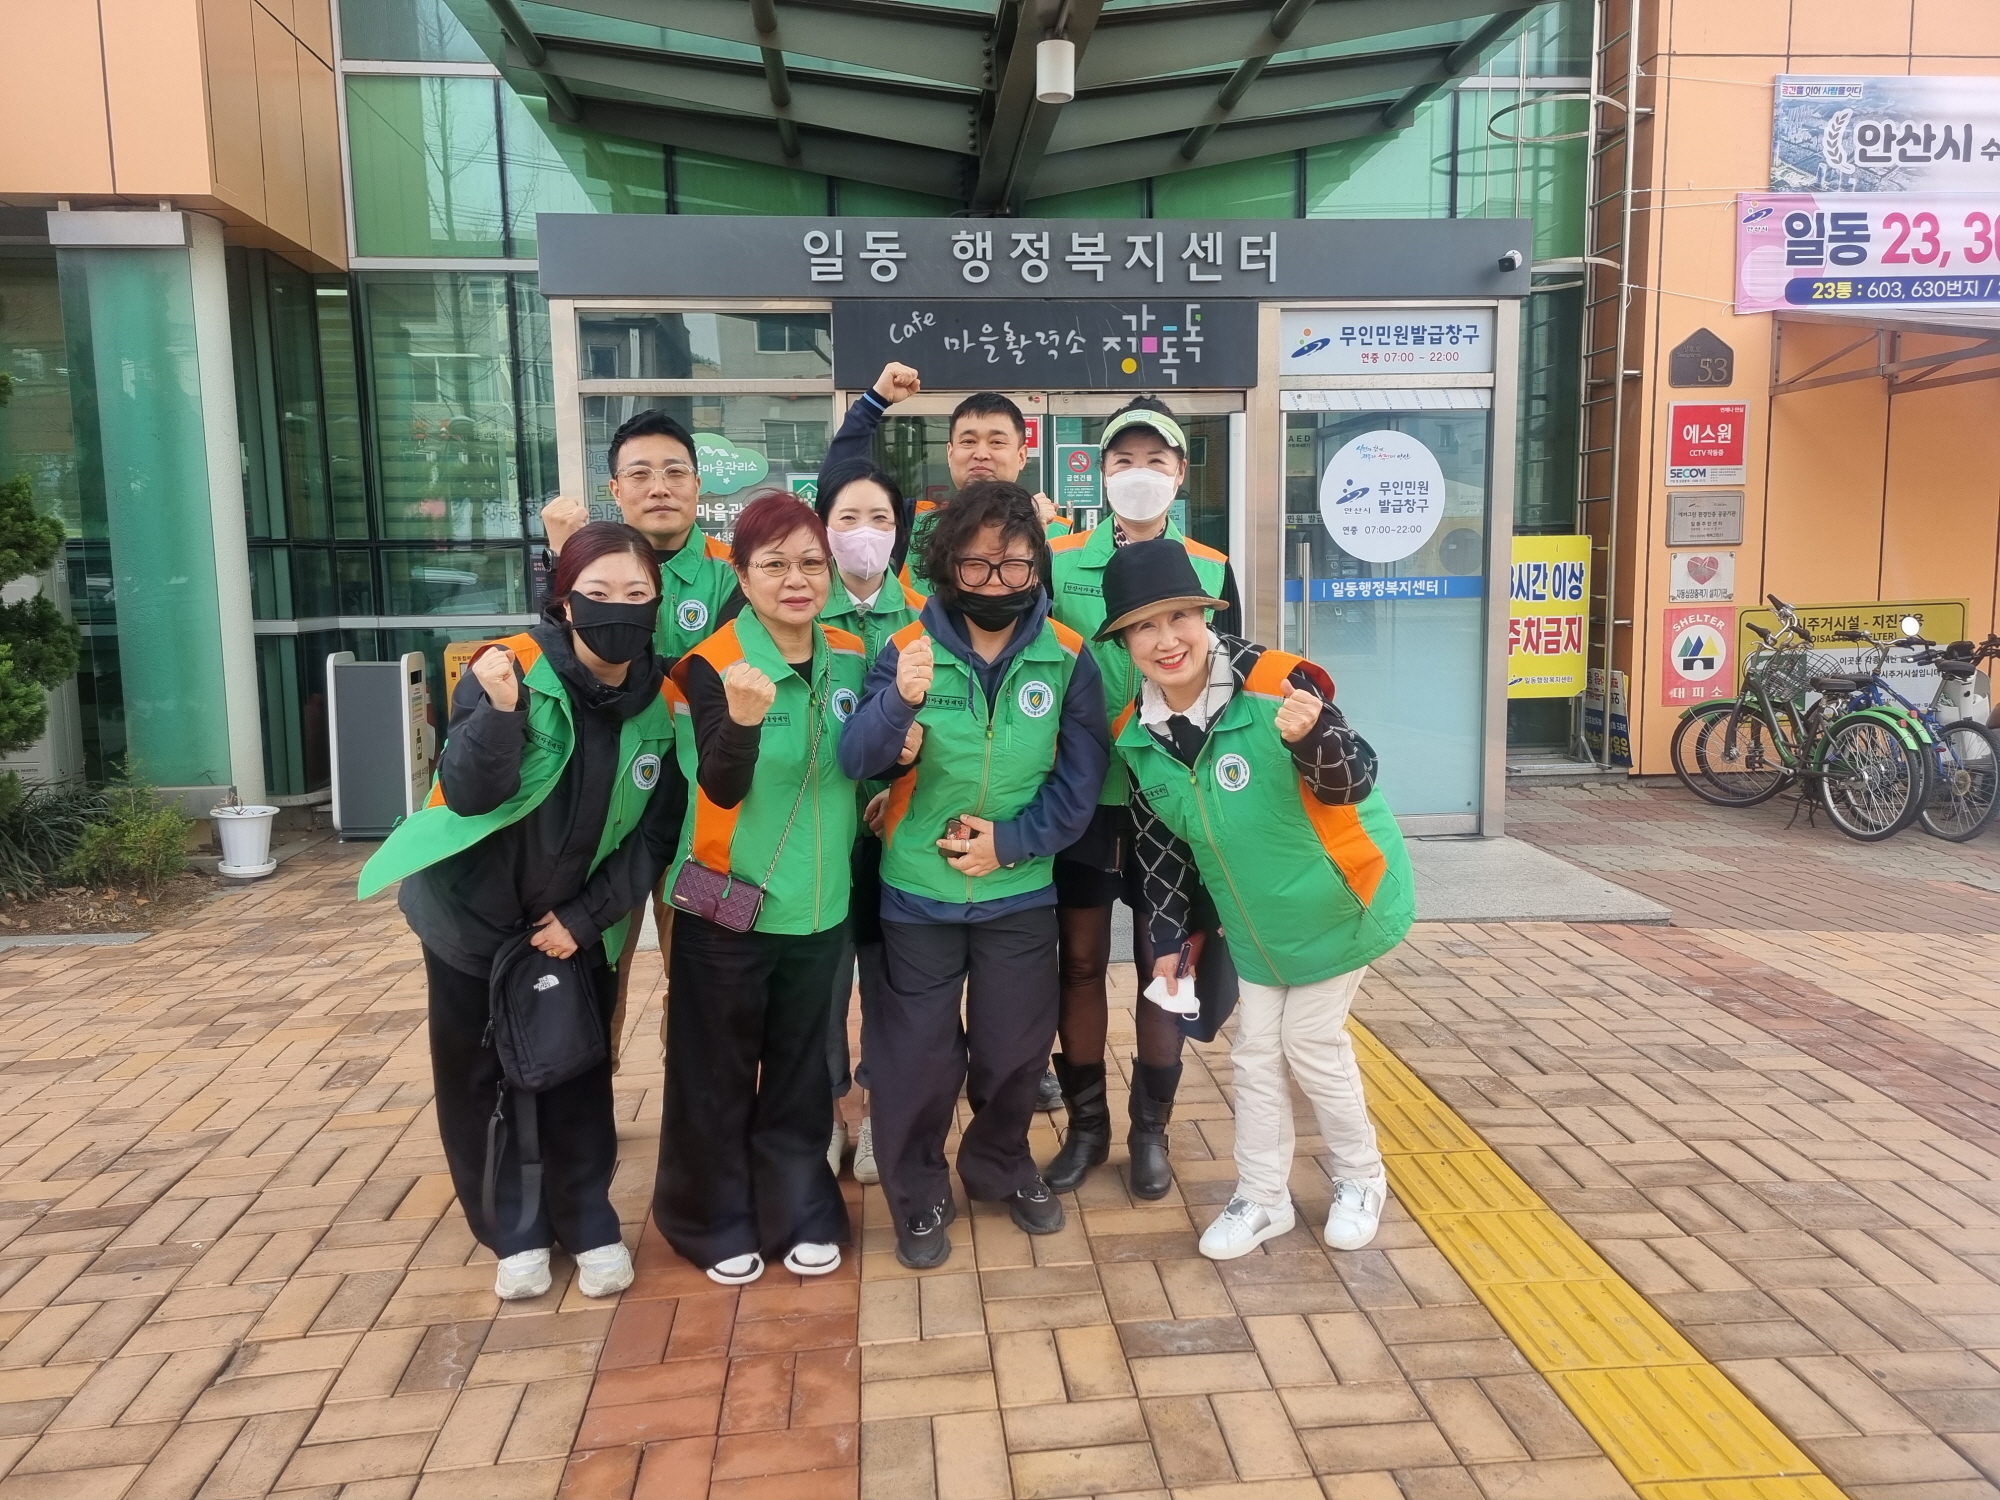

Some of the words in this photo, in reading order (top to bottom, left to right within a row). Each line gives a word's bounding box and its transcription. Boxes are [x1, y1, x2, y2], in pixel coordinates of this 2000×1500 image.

[1782, 86, 1803, 95] 공간을
[1806, 86, 1820, 95] 이어
[1823, 86, 1845, 95] 사람을
[1857, 123, 1973, 162] 안산시
[1784, 212, 1871, 266] 일동
[1881, 212, 1951, 268] 23,
[1963, 211, 2000, 264] 3
[803, 230, 907, 283] 일동
[951, 230, 1278, 284] 행정복지센터
[1812, 281, 1852, 299] 23통
[1867, 281, 1905, 299] 603,
[1911, 280, 1978, 298] 630번지
[889, 311, 936, 344] Cafe
[1339, 324, 1480, 346] 무인민원발급창구
[944, 321, 1086, 364] 마을활력소
[1361, 352, 1379, 364] 연중
[1384, 351, 1414, 363] 07:00
[1429, 351, 1460, 363] 22:00
[1697, 357, 1728, 382] 53
[1288, 434, 1311, 442] AED
[1683, 423, 1732, 444] 에스원
[1066, 474, 1092, 482] 금연건물
[1670, 468, 1706, 478] SECOM
[1378, 481, 1429, 496] 무인민원
[1378, 499, 1429, 514] 발급창구
[1342, 526, 1358, 536] 연중
[1364, 525, 1422, 535] 07:00~22:00
[1331, 579, 1439, 598] 일동행정복지센터
[1552, 563, 1585, 601] 이상
[1676, 588, 1708, 599] 자동심장충격기
[1709, 588, 1728, 599] 설치기관
[1673, 614, 1725, 632] SHELTER
[1789, 614, 1860, 632] 시주거시설
[1509, 616, 1583, 656] 주차금지
[1673, 686, 1722, 698] 대피소
